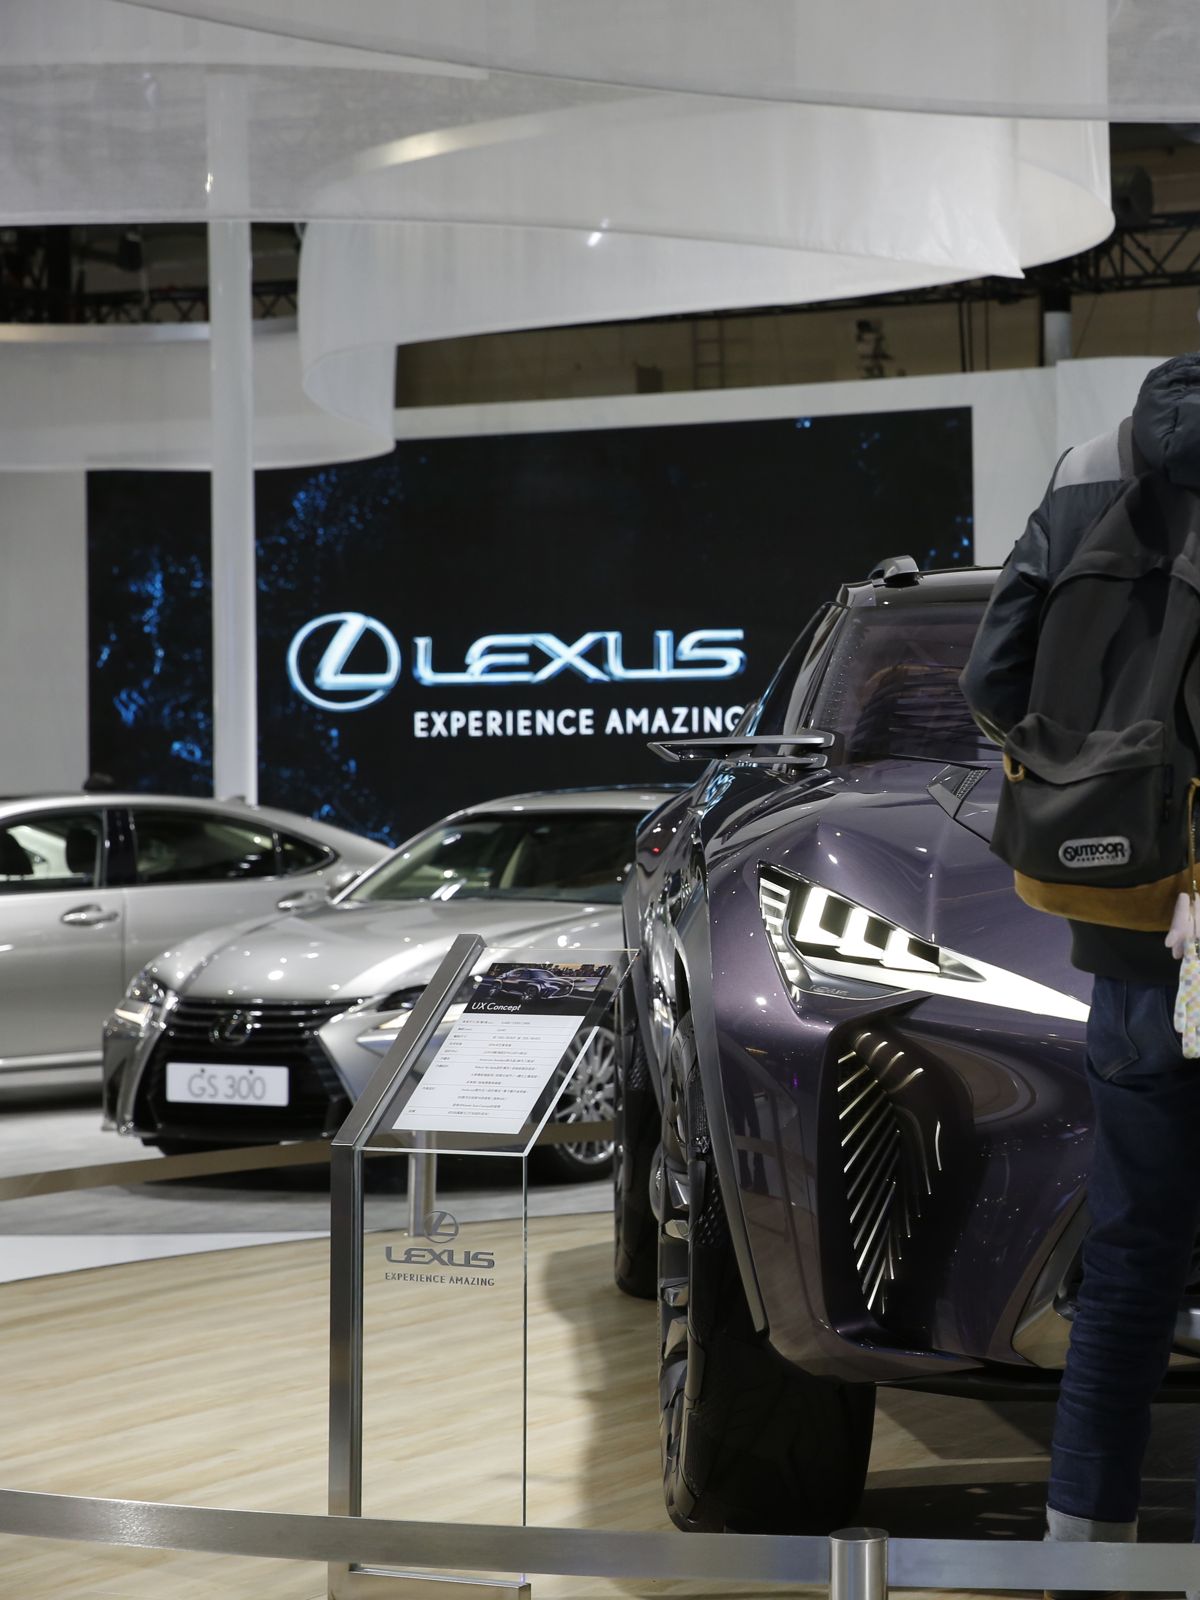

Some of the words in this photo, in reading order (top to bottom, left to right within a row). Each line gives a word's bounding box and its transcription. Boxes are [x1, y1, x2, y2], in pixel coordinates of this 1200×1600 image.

[412, 629, 747, 686] LEXUS
[414, 707, 595, 738] EXPERIENCE
[604, 704, 746, 735] AMAZING
[1063, 842, 1126, 862] OUTDOOR
[471, 1002, 487, 1010] UX
[487, 1002, 522, 1012] Concept
[187, 1073, 219, 1099] GS
[224, 1075, 266, 1100] 300
[385, 1246, 495, 1269] LEXUS
[385, 1272, 446, 1284] EXPERIENCE
[449, 1275, 495, 1287] AMAZING
